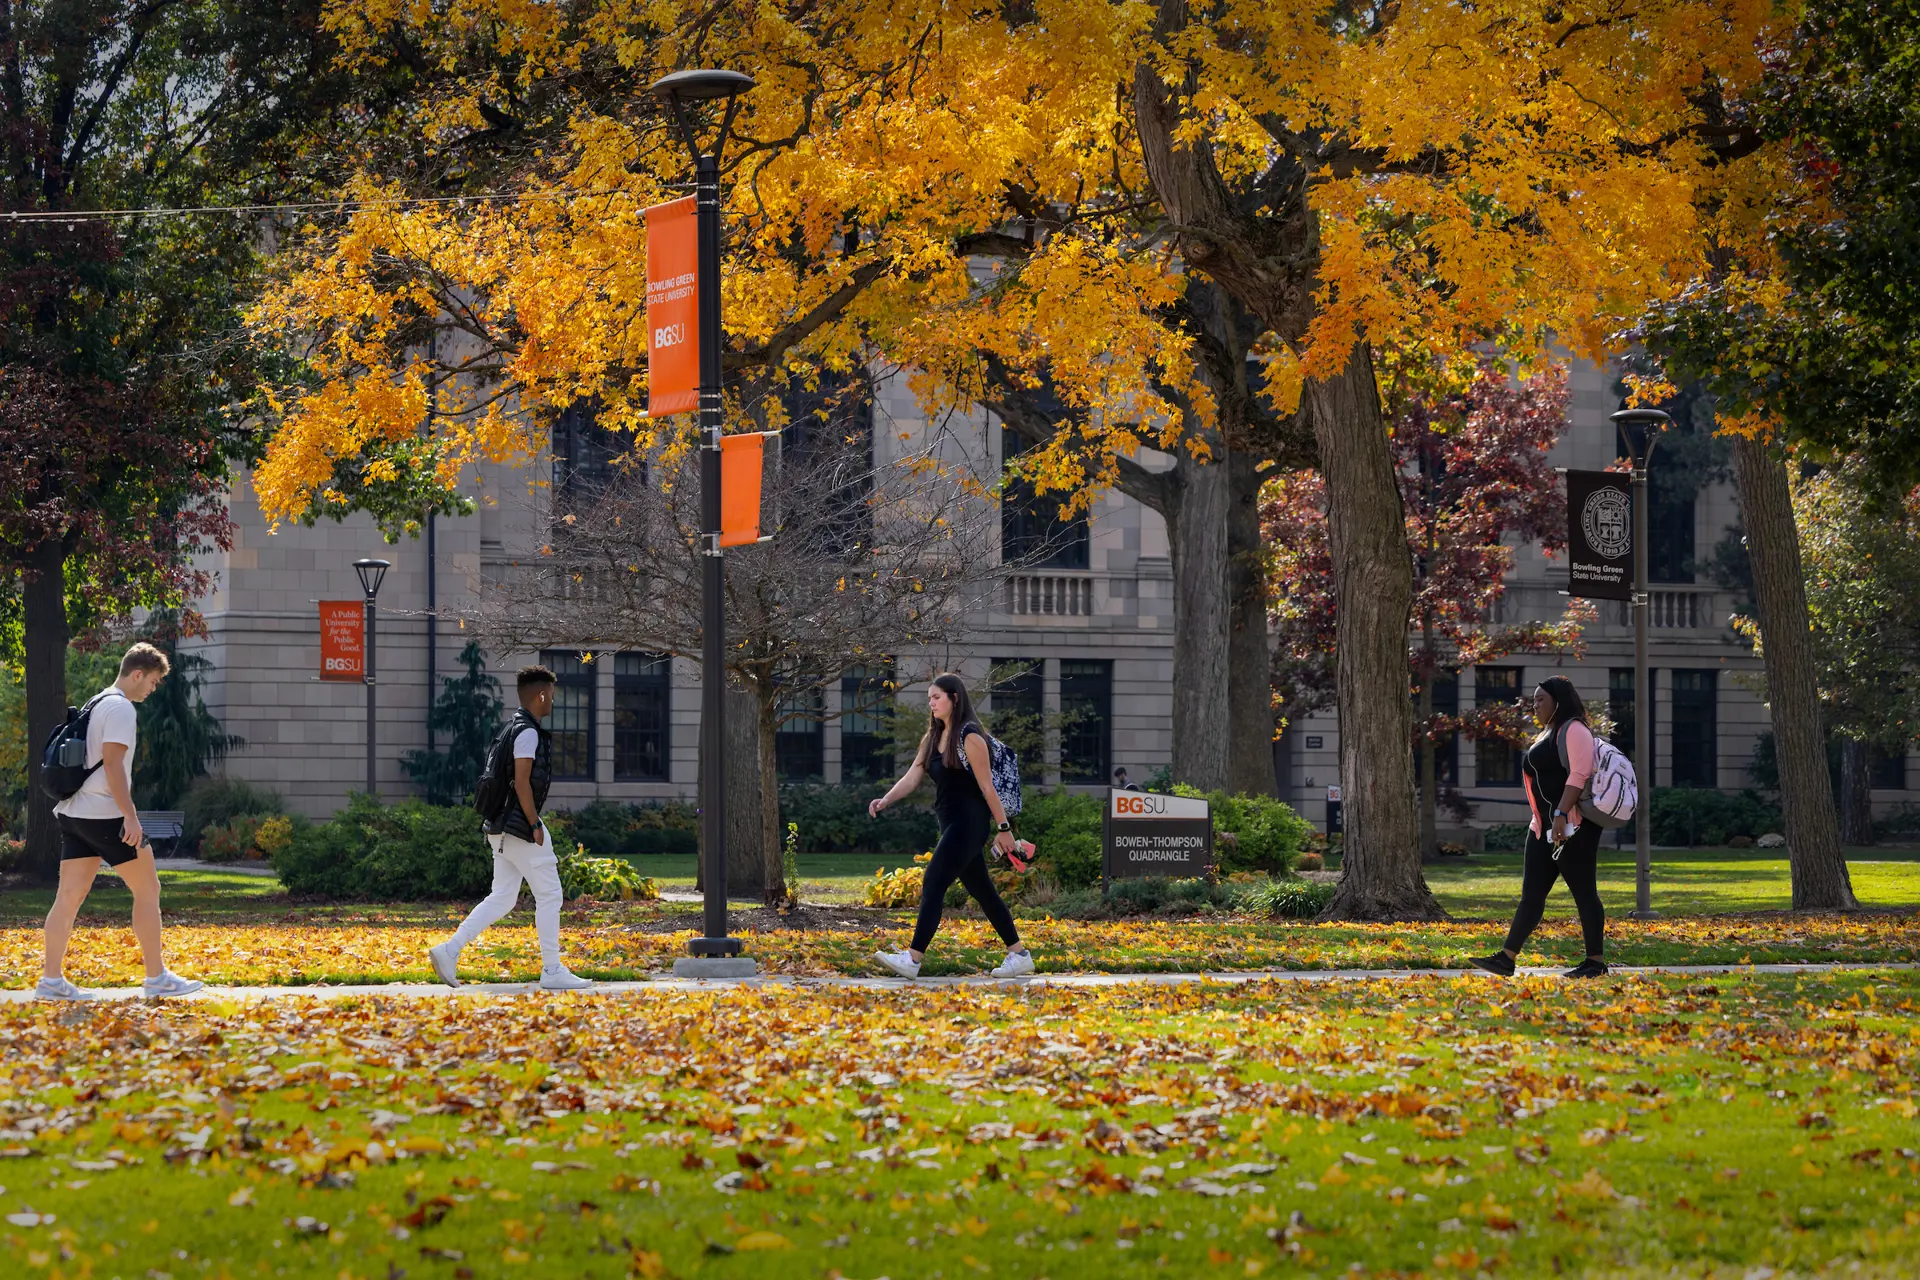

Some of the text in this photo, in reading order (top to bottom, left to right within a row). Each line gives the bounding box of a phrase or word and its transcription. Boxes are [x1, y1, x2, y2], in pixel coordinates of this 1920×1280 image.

[676, 272, 695, 286] GREEN
[647, 285, 695, 306] STATE UNIVERSITY
[655, 322, 685, 349] BGSU
[1606, 491, 1627, 504] STATE
[1572, 562, 1624, 574] Bowling Green
[1572, 570, 1622, 583] State University
[332, 610, 360, 618] A Public
[325, 618, 360, 628] University
[329, 627, 351, 636] for the
[333, 635, 356, 644] Public
[325, 658, 361, 672] BGSU
[1116, 796, 1165, 814] BGSU
[1115, 836, 1203, 848] BOWEN-THOMPSON
[1129, 850, 1190, 861] QUADRANGLE
